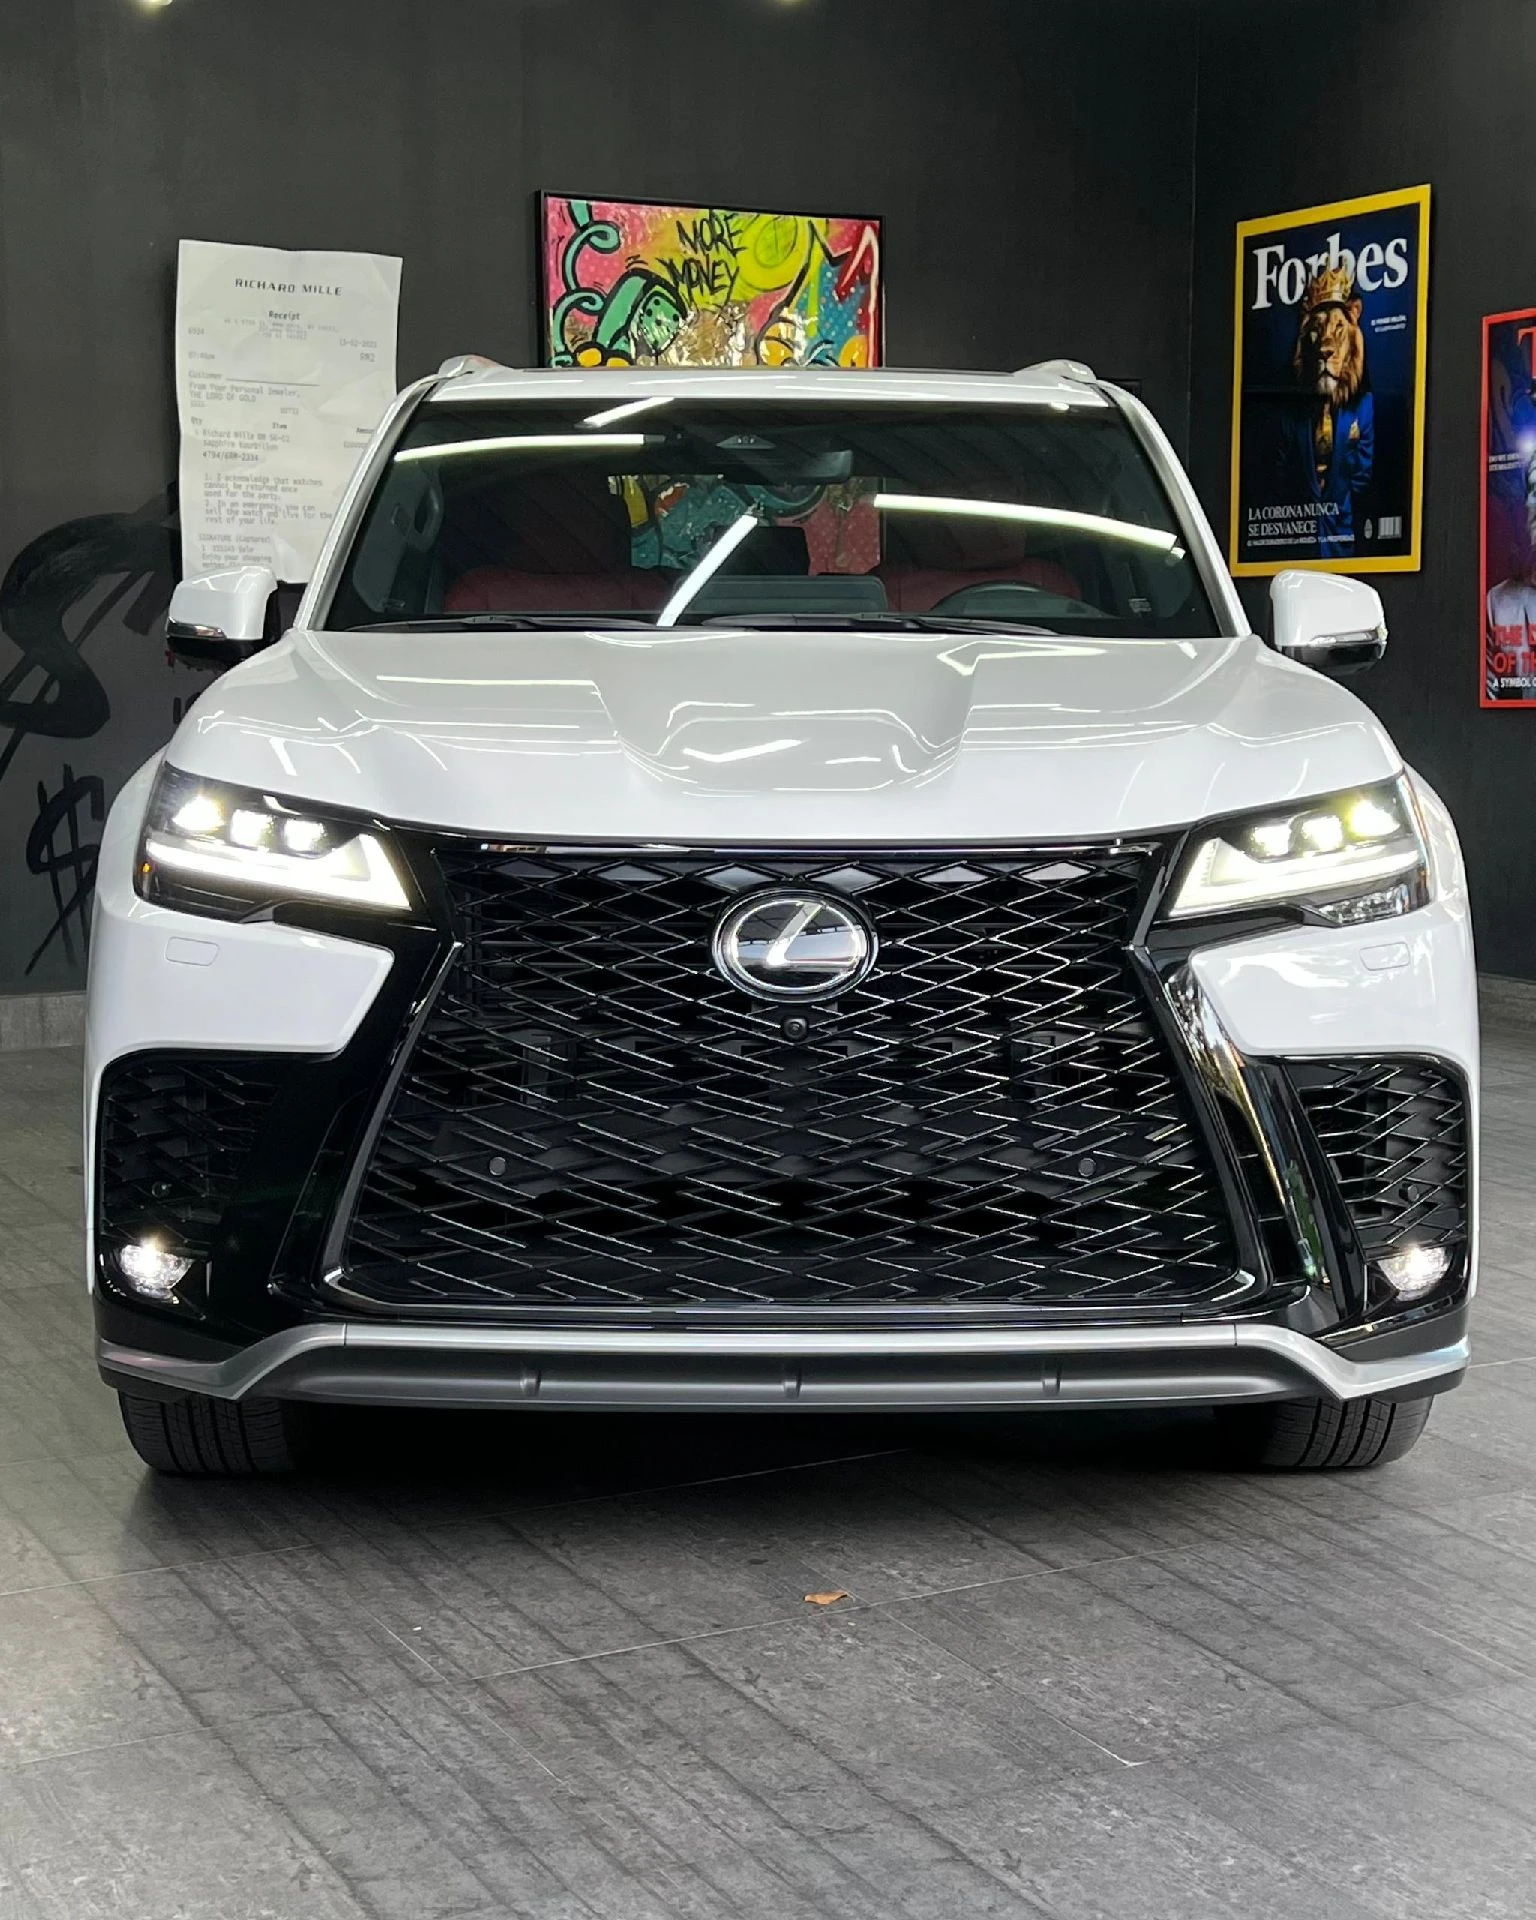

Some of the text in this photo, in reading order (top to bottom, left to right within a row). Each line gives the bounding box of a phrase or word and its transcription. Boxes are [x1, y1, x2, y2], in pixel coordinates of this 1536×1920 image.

[676, 209, 747, 257] MORE
[1252, 233, 1408, 310] Forbes
[234, 278, 343, 297] RICHARD MILLE
[655, 254, 740, 318] MONEY
[268, 310, 301, 321] Receipt
[1248, 502, 1340, 521] LA CORONA NUNCA
[1248, 520, 1318, 537] SE DESVANECE
[1493, 624, 1522, 646] THE
[1493, 652, 1517, 674] OF
[1500, 676, 1532, 689] SYMBOL
